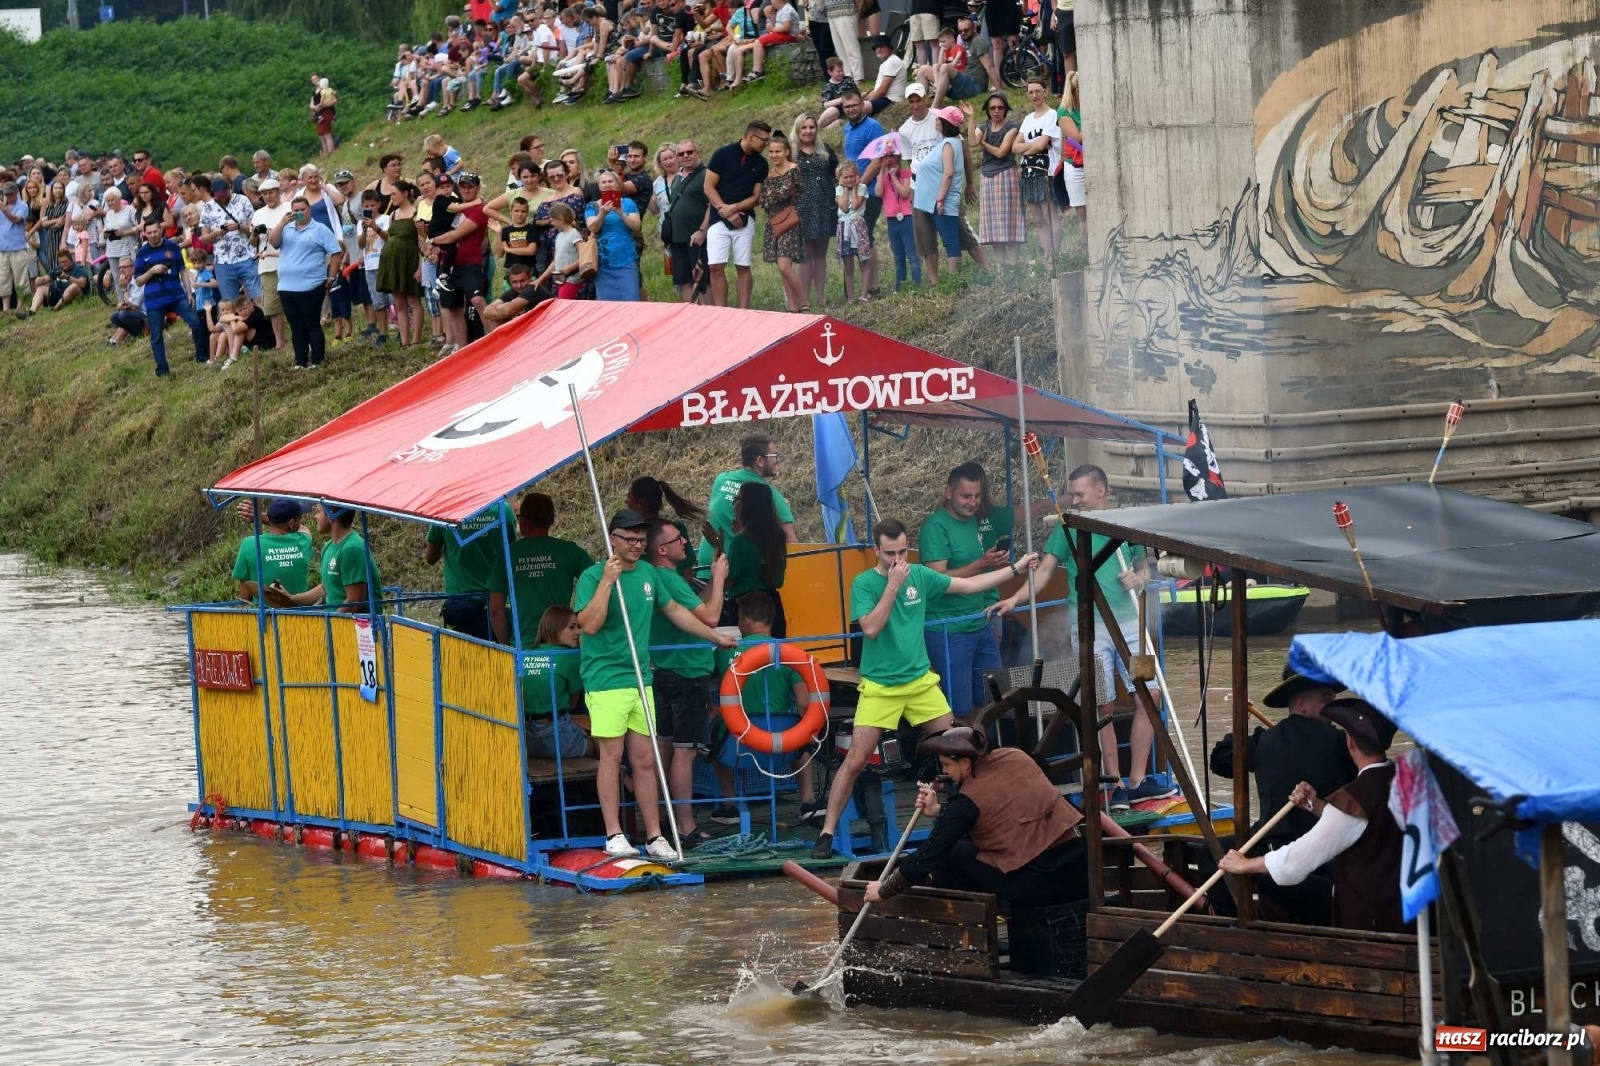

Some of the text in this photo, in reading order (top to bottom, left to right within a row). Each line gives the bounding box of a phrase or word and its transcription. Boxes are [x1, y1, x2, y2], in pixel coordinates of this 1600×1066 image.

[680, 367, 976, 427] BŁAŻEJOWICE
[528, 570, 545, 578] 2021
[361, 660, 376, 689] 18
